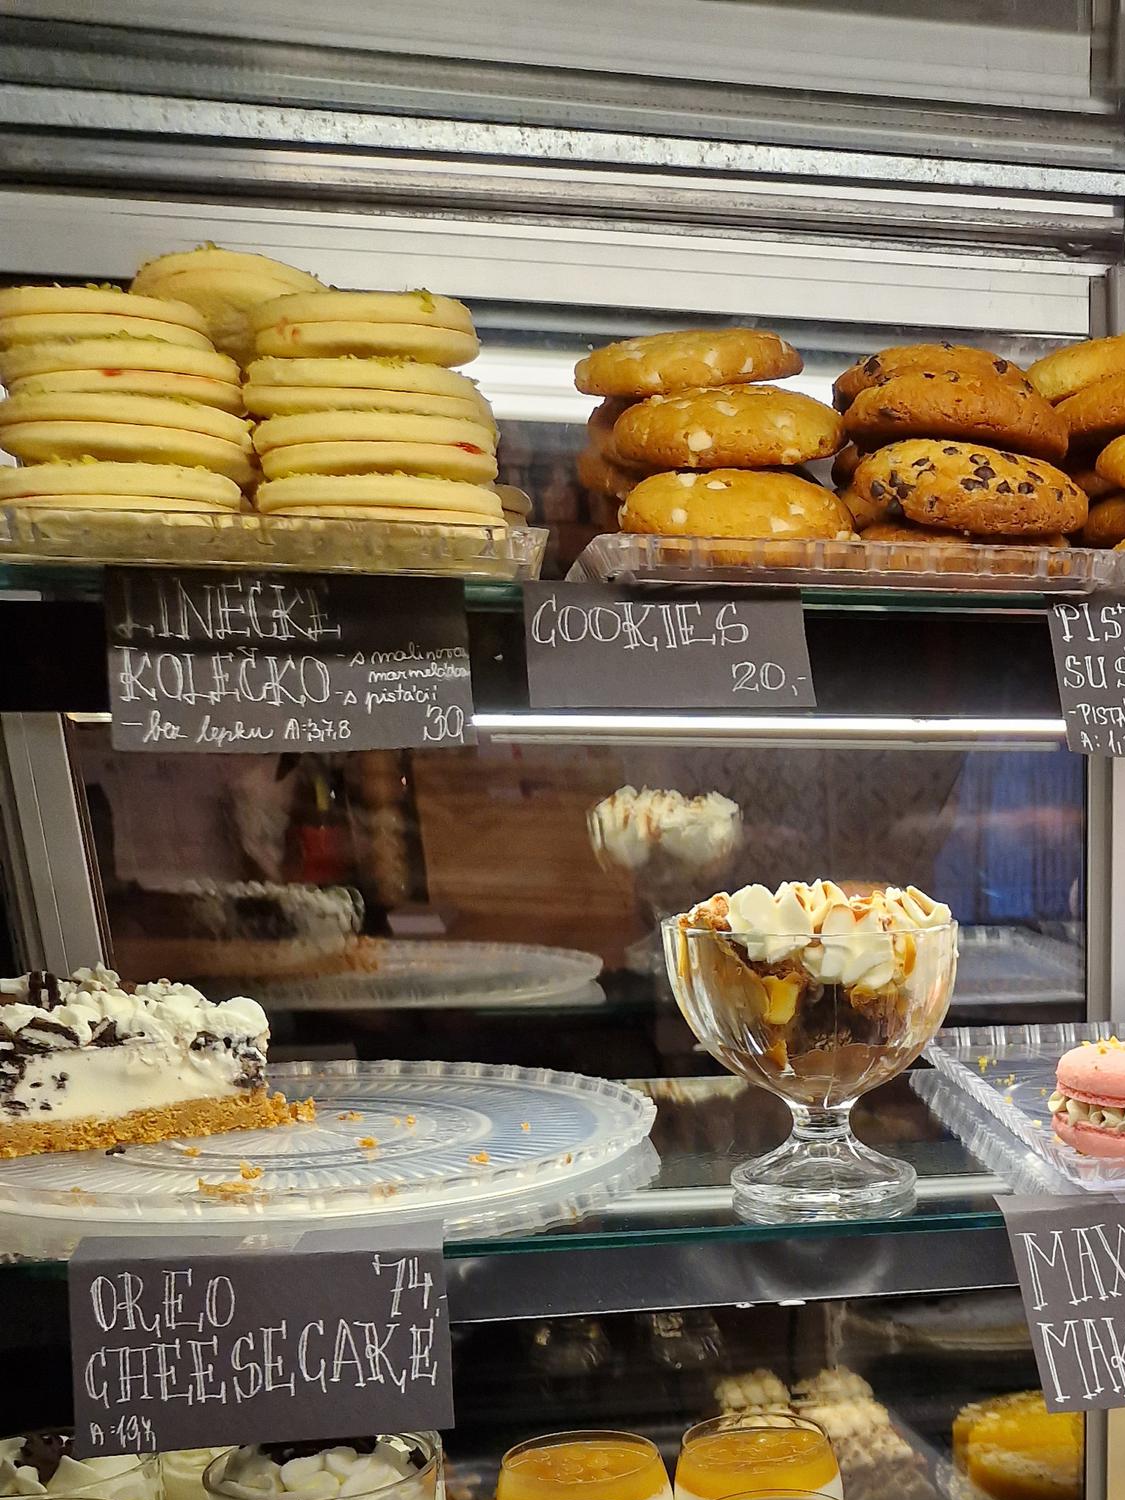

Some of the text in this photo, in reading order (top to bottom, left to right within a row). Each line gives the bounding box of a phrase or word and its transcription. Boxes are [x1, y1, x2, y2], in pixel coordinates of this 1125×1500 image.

[531, 594, 749, 651] COOKIES
[114, 645, 332, 706] KOLEČKO
[731, 662, 807, 696] 20,-
[196, 715, 274, 747] lepku
[90, 1267, 236, 1338] OREO
[84, 1317, 437, 1409] CHEESECAKE
